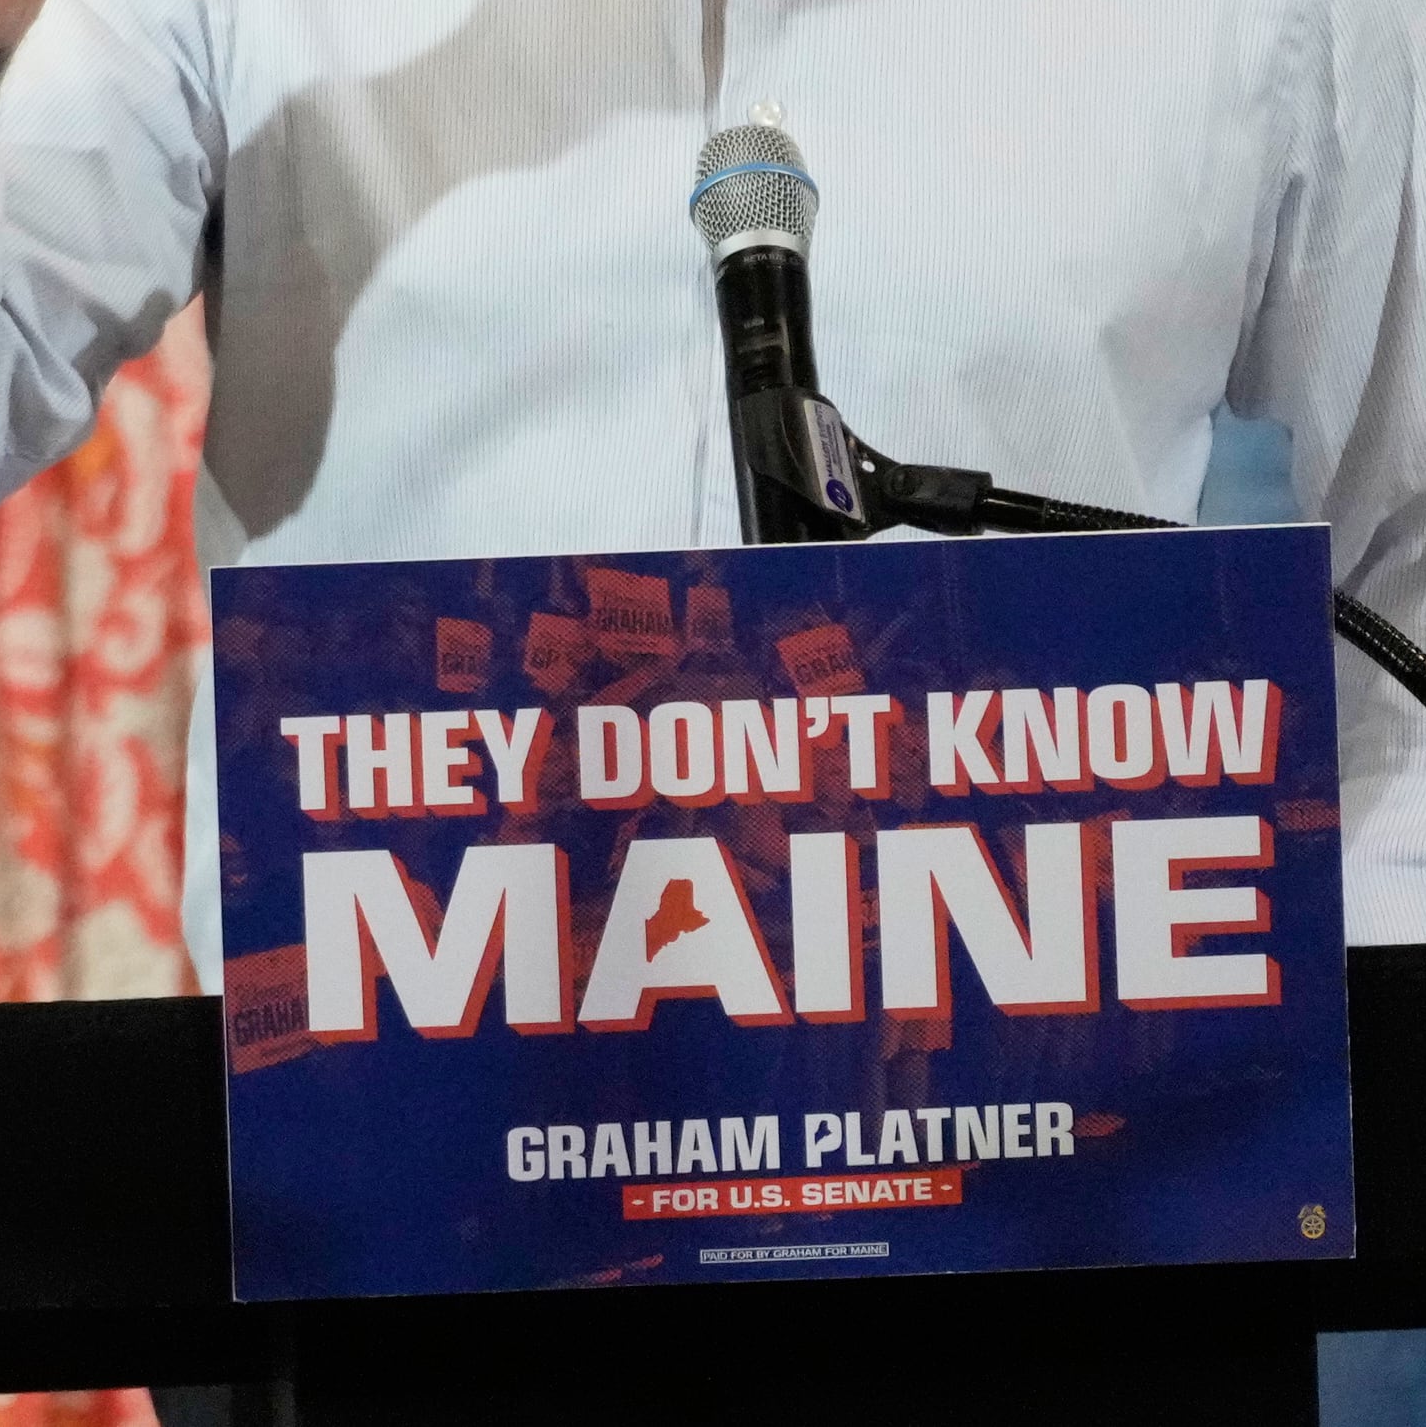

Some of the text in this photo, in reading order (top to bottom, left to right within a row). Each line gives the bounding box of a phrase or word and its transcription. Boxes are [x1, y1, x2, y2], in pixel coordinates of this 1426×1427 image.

[279, 677, 1284, 819] THEY DON'T KNOW
[301, 814, 1283, 1041] MAINE
[506, 1101, 1075, 1182] GRAHAM PLATNER
[651, 1177, 933, 1213] FOR U.S. SENATE
[703, 1244, 887, 1262] PAID FOR BY GRAHAM FOR MAINE
